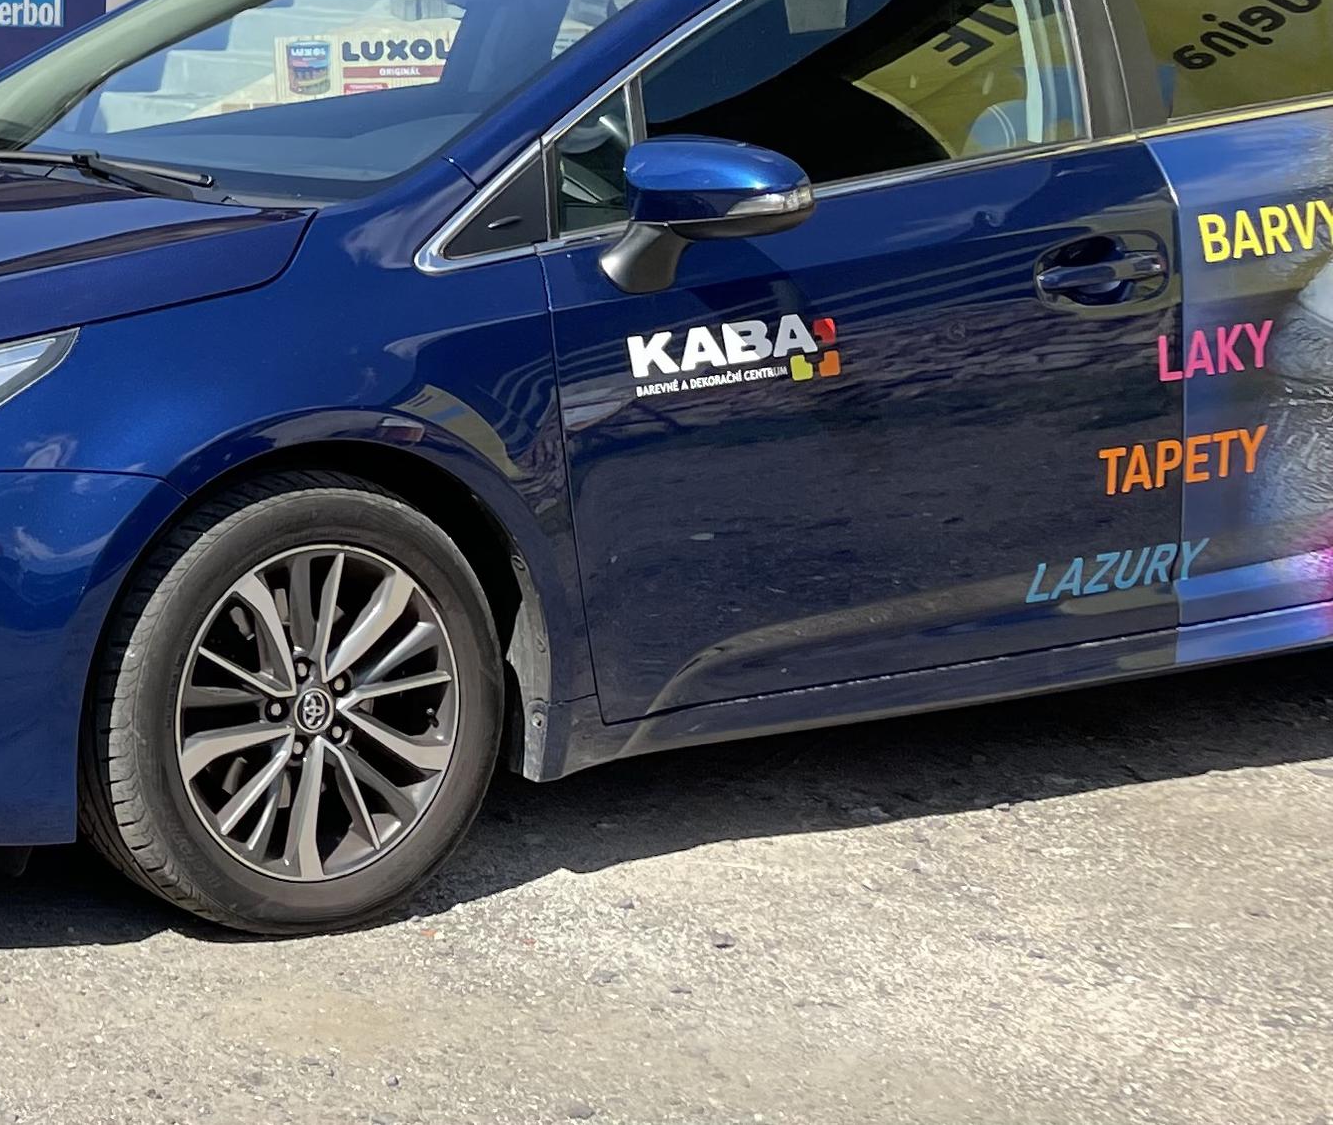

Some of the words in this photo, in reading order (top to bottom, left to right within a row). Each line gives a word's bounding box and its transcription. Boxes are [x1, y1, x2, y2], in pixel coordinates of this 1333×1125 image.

[342, 38, 450, 62] LUXOL
[627, 314, 818, 378] KABA
[1158, 320, 1273, 382] LAKY
[636, 379, 679, 397] BAREVNÉ
[681, 379, 690, 391] A
[690, 369, 742, 390] DEKORAČNÍ
[744, 365, 788, 382] CENTRUM
[1099, 425, 1268, 495] TAPETY
[1026, 538, 1209, 604] LAZURY
